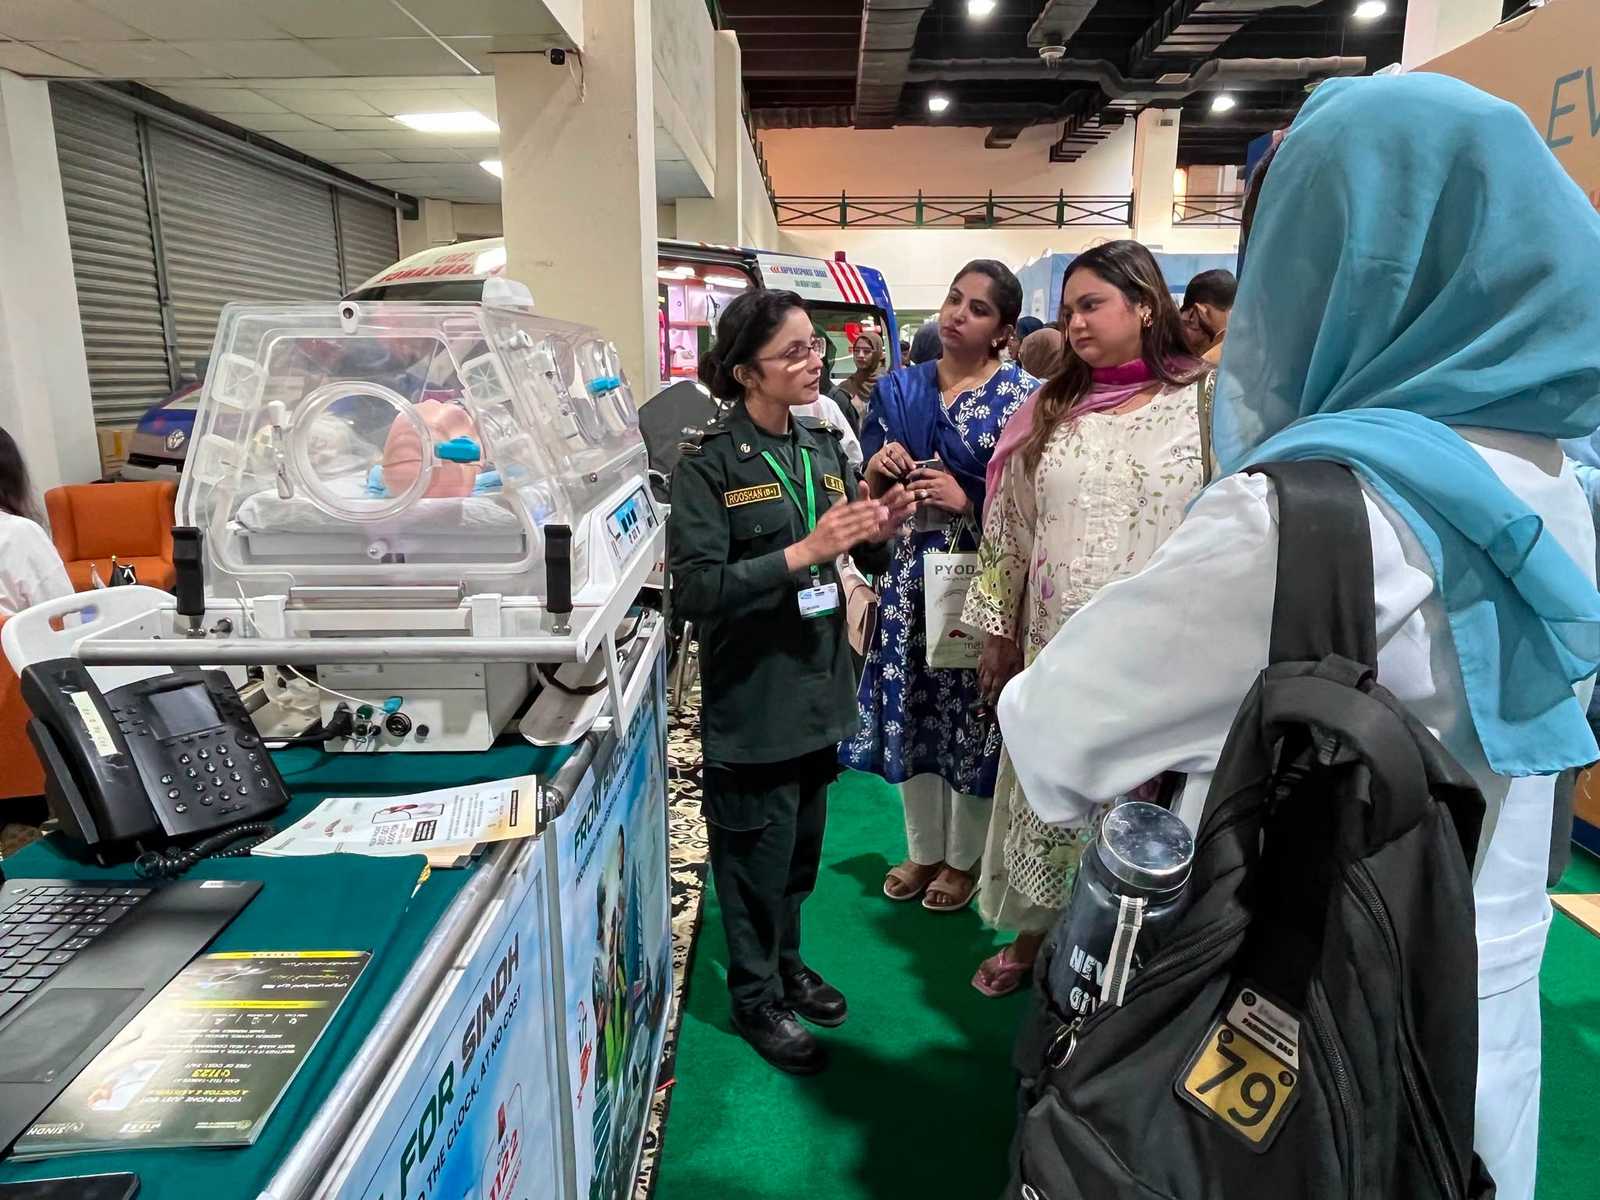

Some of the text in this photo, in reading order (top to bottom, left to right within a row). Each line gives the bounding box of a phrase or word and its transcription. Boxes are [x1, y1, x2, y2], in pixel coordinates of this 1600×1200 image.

[728, 488, 763, 504] ROOSHAN
[401, 932, 519, 1200] FOR SINDH
[426, 1145, 446, 1193] THE
[480, 1049, 490, 1082] AT
[491, 1024, 503, 1057] NO
[503, 984, 522, 1030] COST
[1196, 1043, 1276, 1127] 79
[27, 1127, 64, 1136] SINDH
